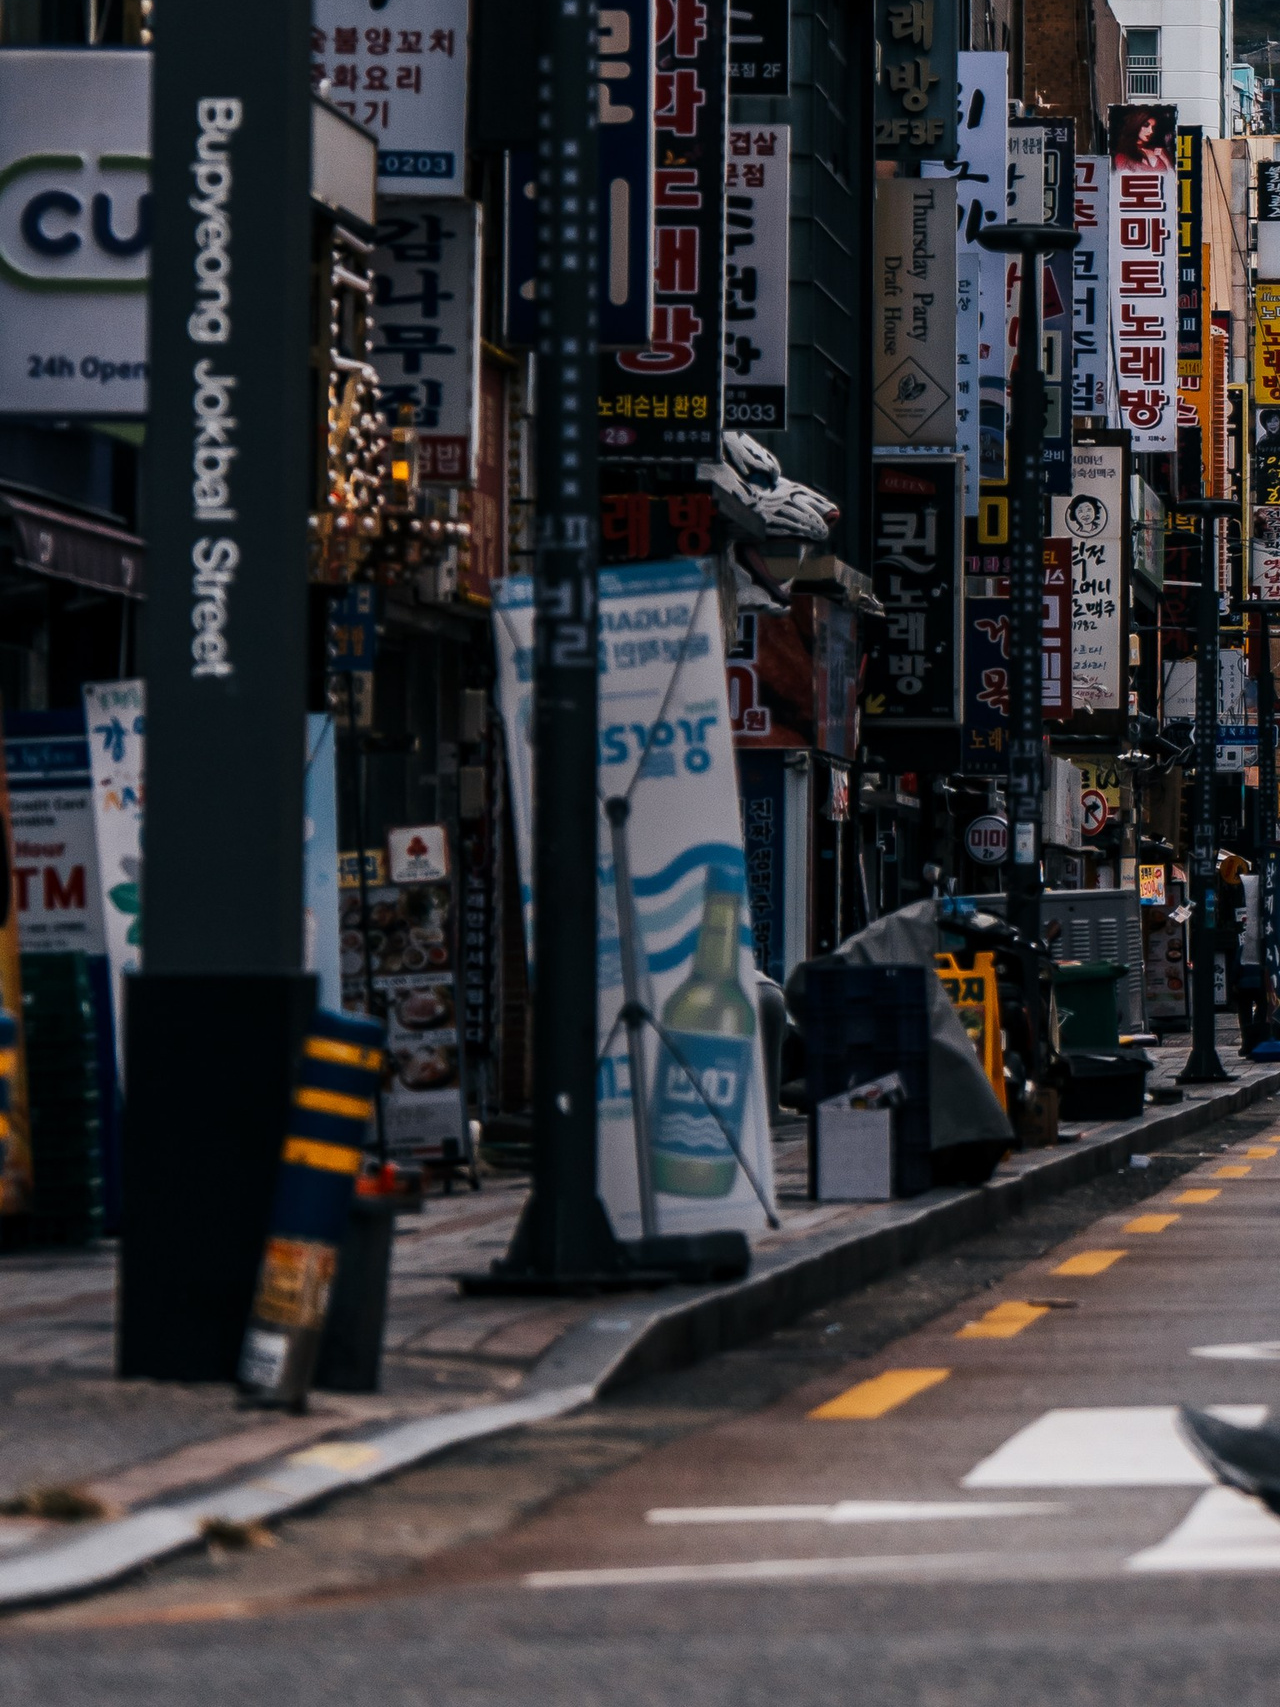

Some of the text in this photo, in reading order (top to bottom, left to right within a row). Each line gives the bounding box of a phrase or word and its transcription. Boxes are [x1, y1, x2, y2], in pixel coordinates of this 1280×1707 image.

[20, 190, 151, 257] CU
[906, 188, 934, 345] Thursday Party
[883, 255, 903, 357] Draft House
[1118, 173, 1170, 430] 토마토노래방
[27, 353, 74, 381] 24h
[188, 97, 242, 678] Bupyeong Jokbal Street
[602, 494, 717, 559] 래방
[885, 575, 932, 695] 노래방
[16, 864, 87, 910] TM
